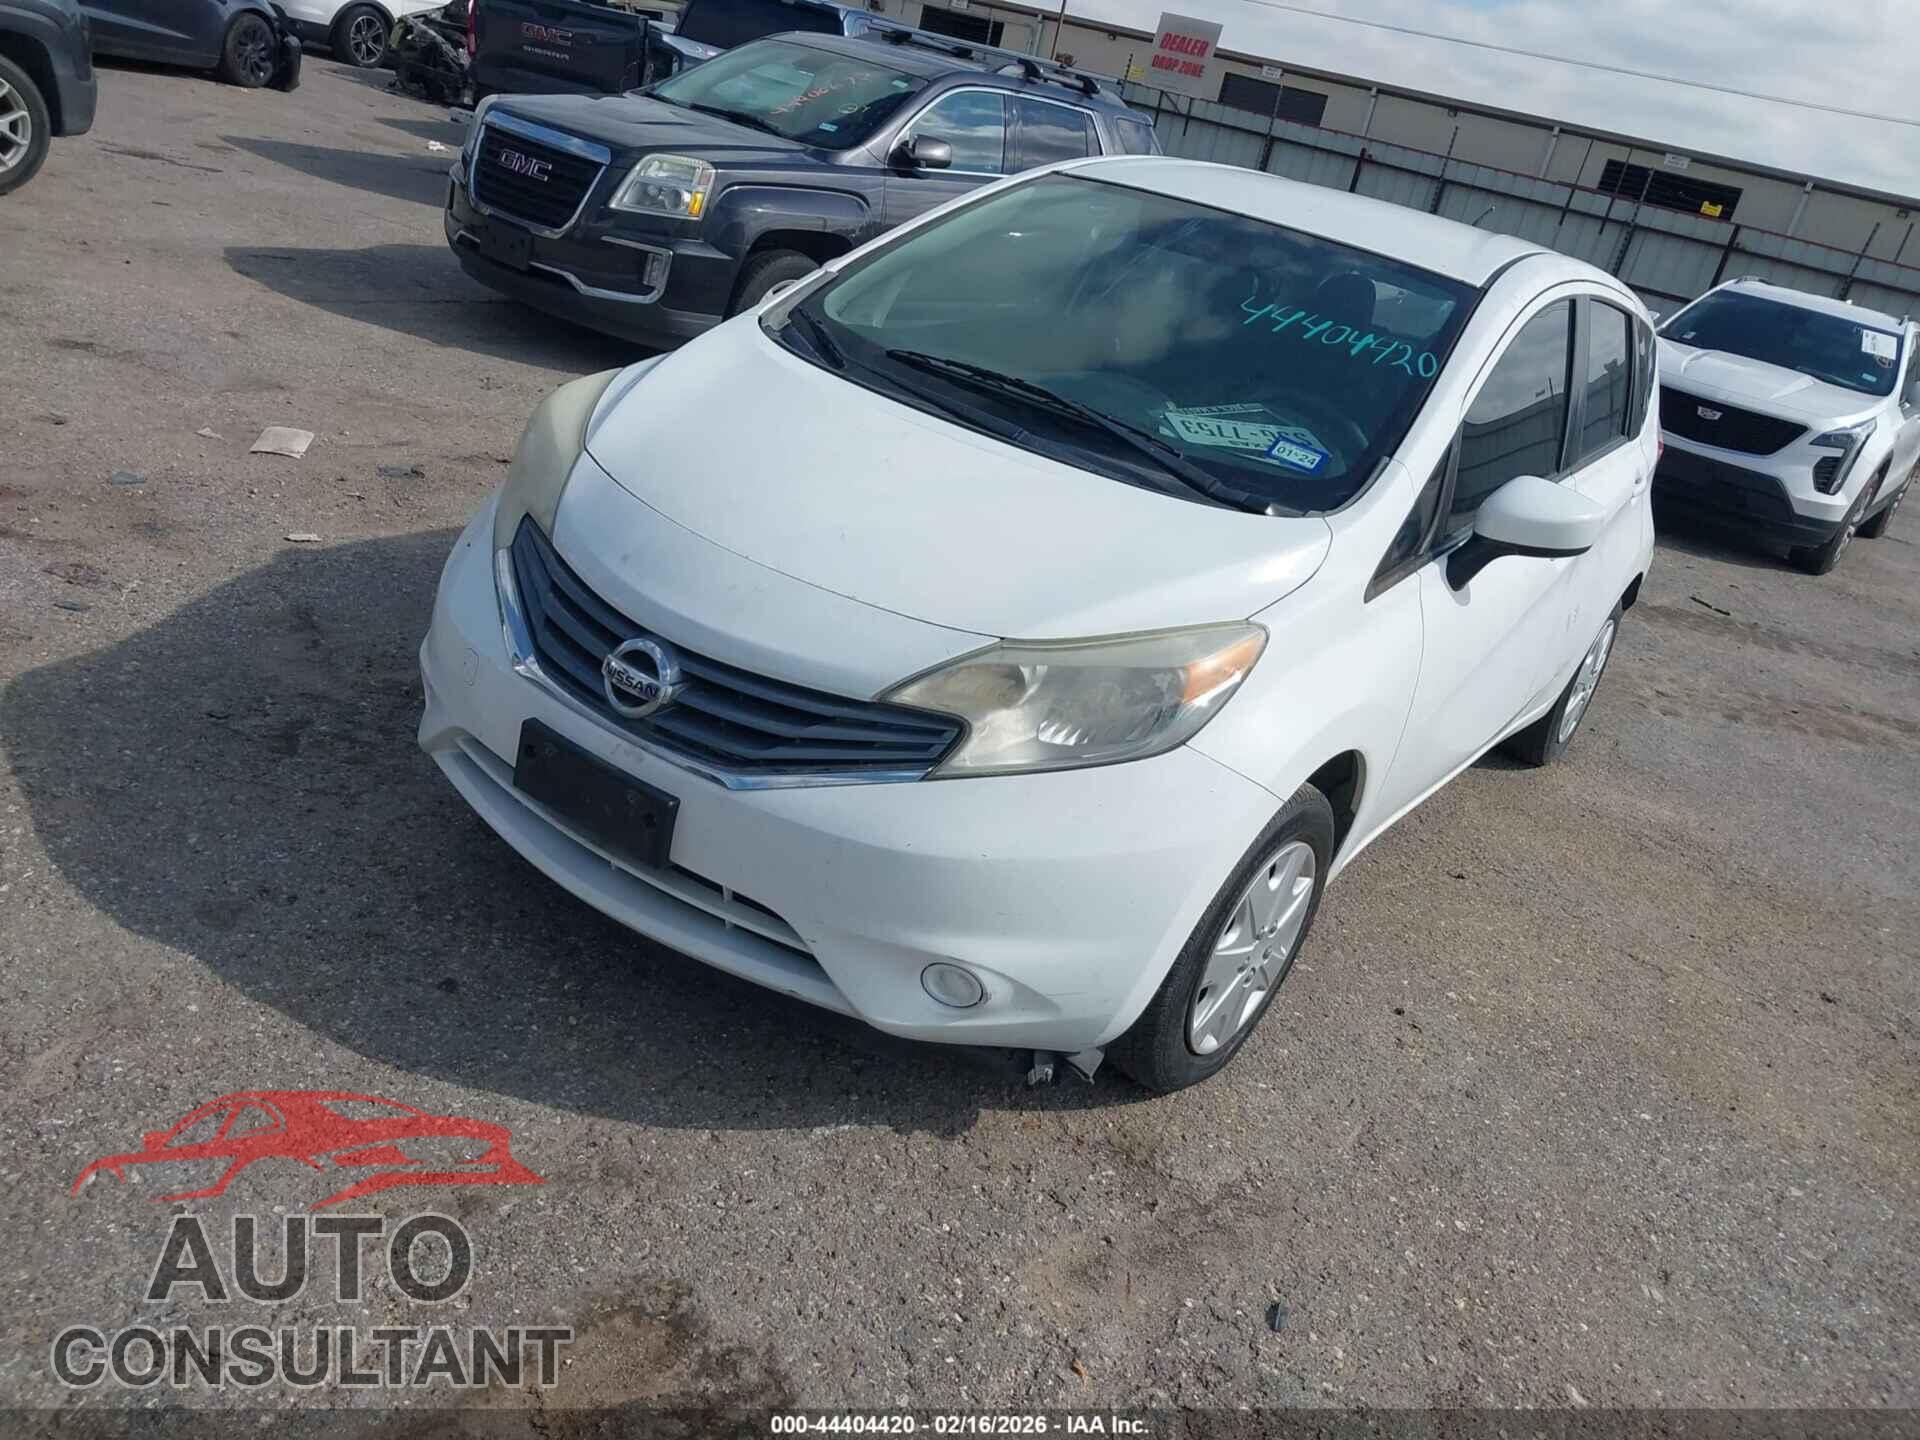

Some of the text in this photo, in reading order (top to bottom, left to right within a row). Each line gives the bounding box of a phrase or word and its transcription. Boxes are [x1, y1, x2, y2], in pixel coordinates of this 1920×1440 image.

[521, 22, 573, 47] GMC
[1159, 31, 1210, 59] DEALER
[1151, 54, 1180, 73] DROP
[1178, 60, 1206, 79] ZONE
[499, 148, 553, 182] GMC
[1240, 295, 1438, 378] 44404420
[605, 661, 658, 697] NISSAN
